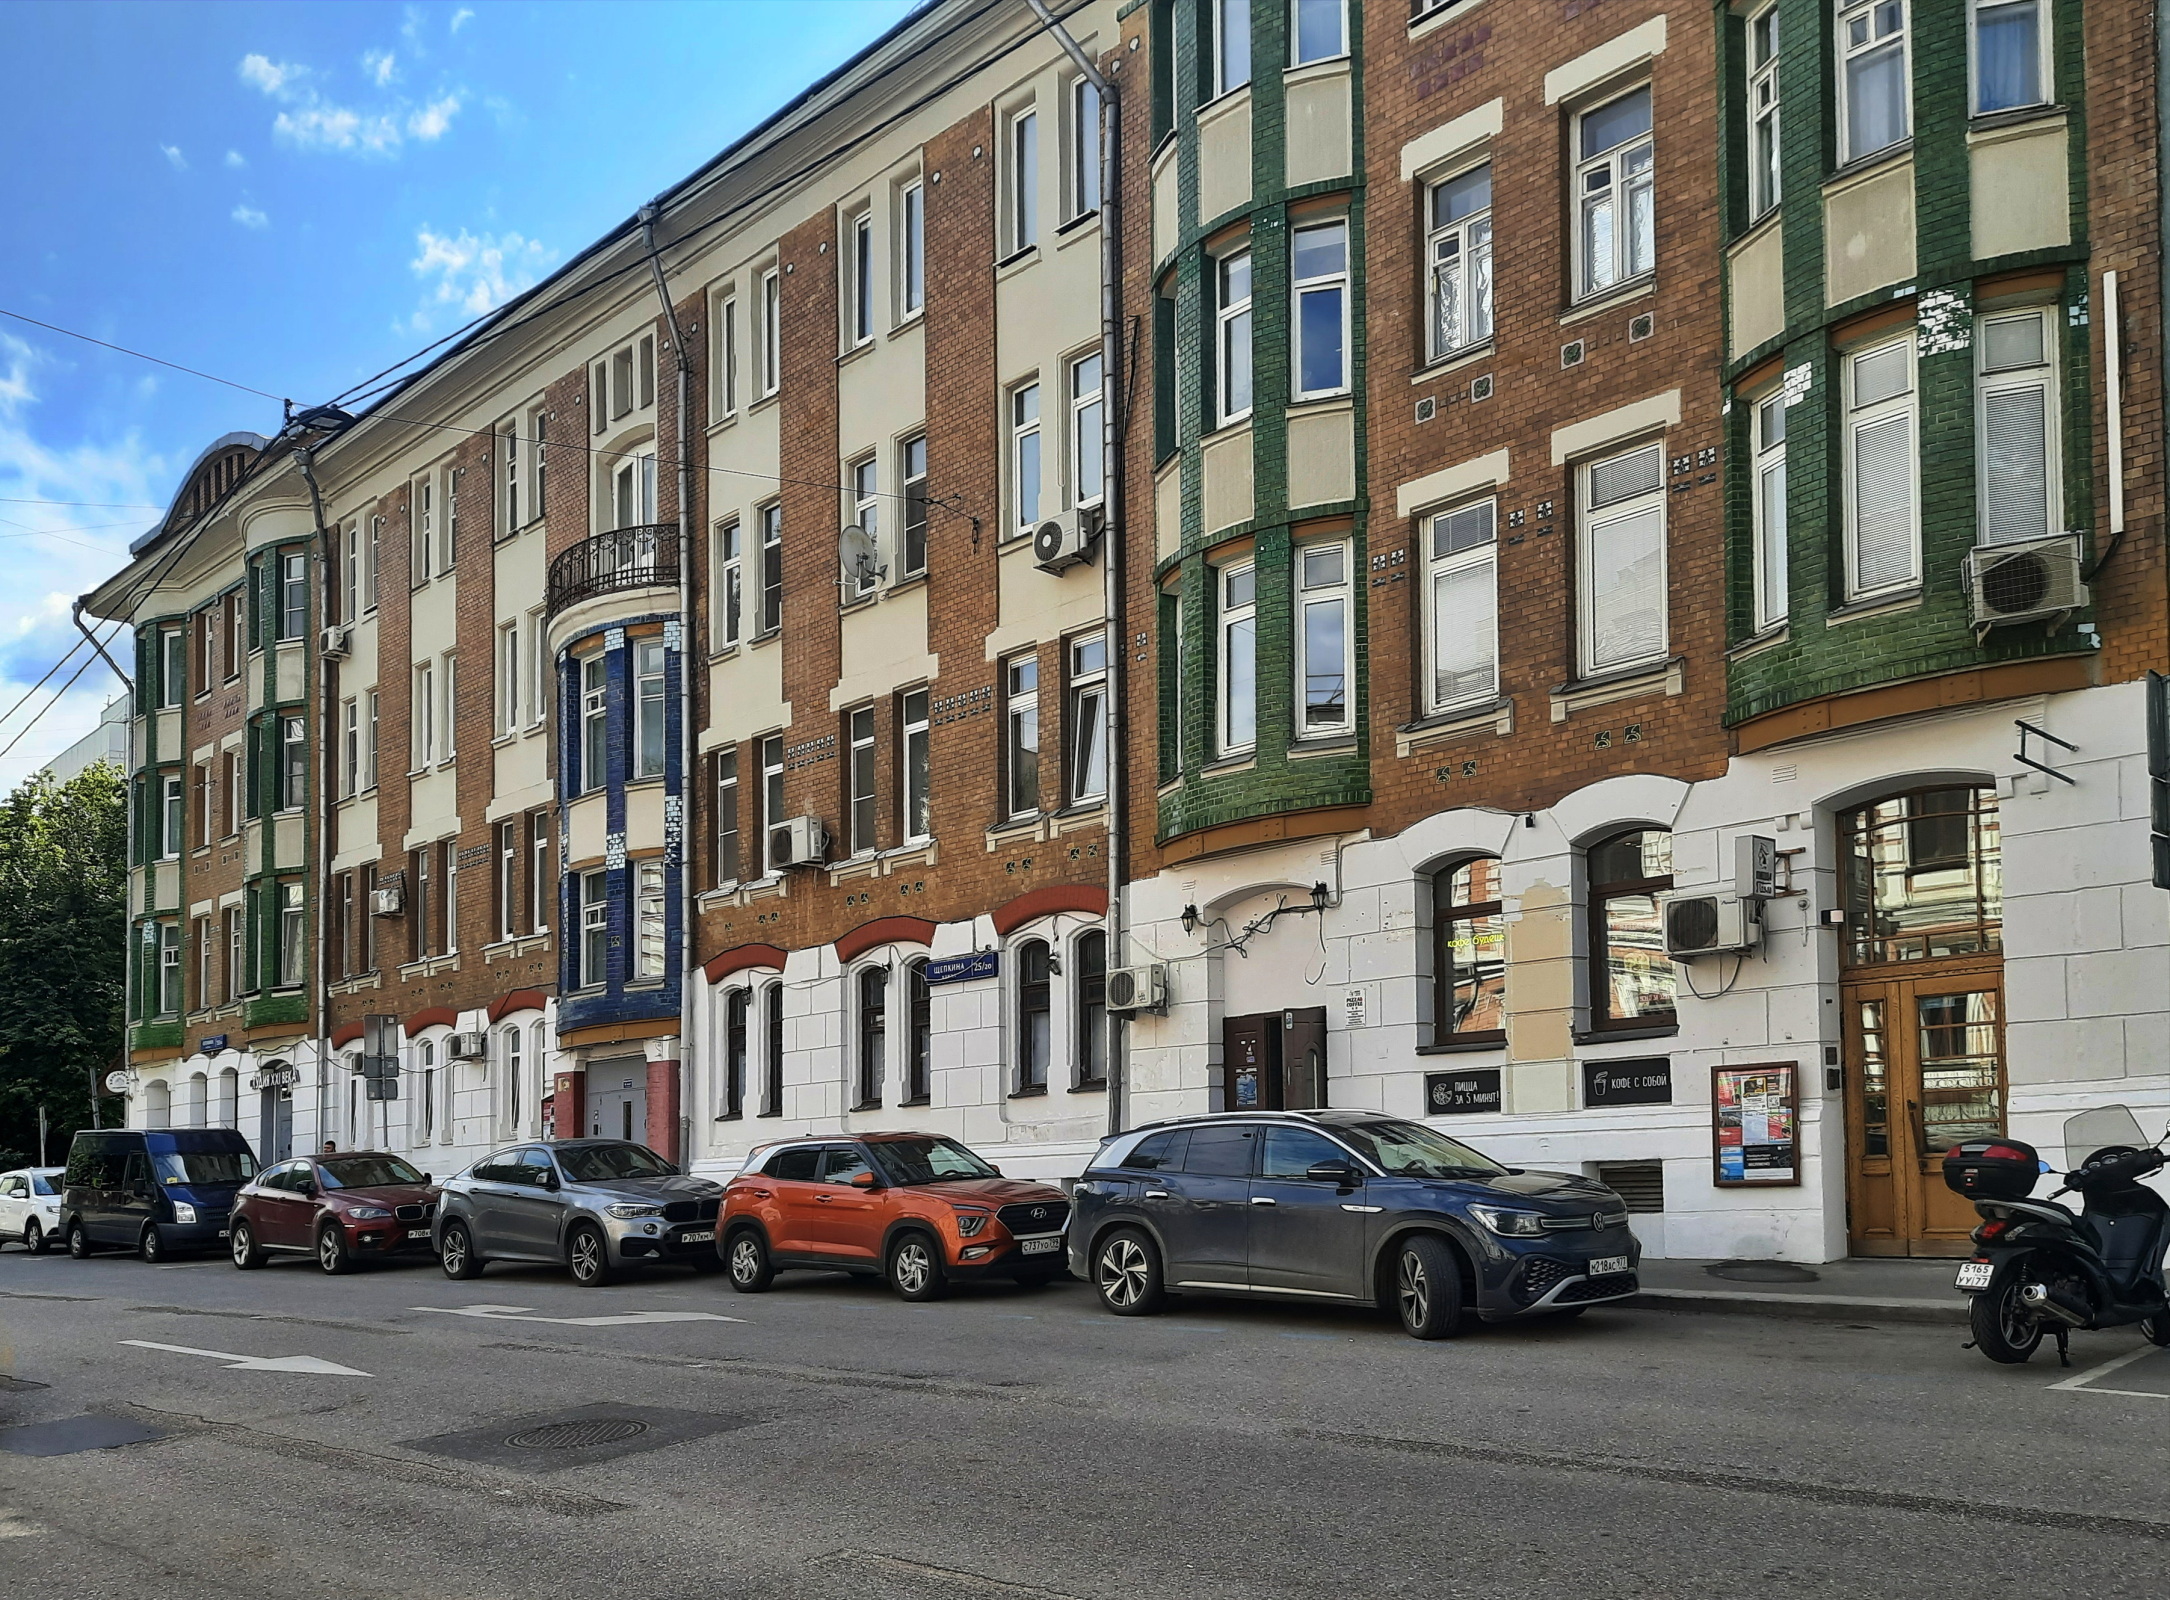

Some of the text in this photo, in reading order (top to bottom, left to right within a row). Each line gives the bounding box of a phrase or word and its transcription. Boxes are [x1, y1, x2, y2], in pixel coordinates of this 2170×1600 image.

[1447, 938, 1470, 948] кофе
[933, 961, 992, 974] ЩЕПКИНА 25/20
[281, 1070, 297, 1084] ВЕКА
[1611, 1073, 1667, 1089] КОФЕ С СОБОЙ
[1454, 1080, 1478, 1092] ПИЦЦА
[1455, 1090, 1499, 1105] ЗА 5 МИНУТ!
[1963, 1264, 1989, 1273] 5165
